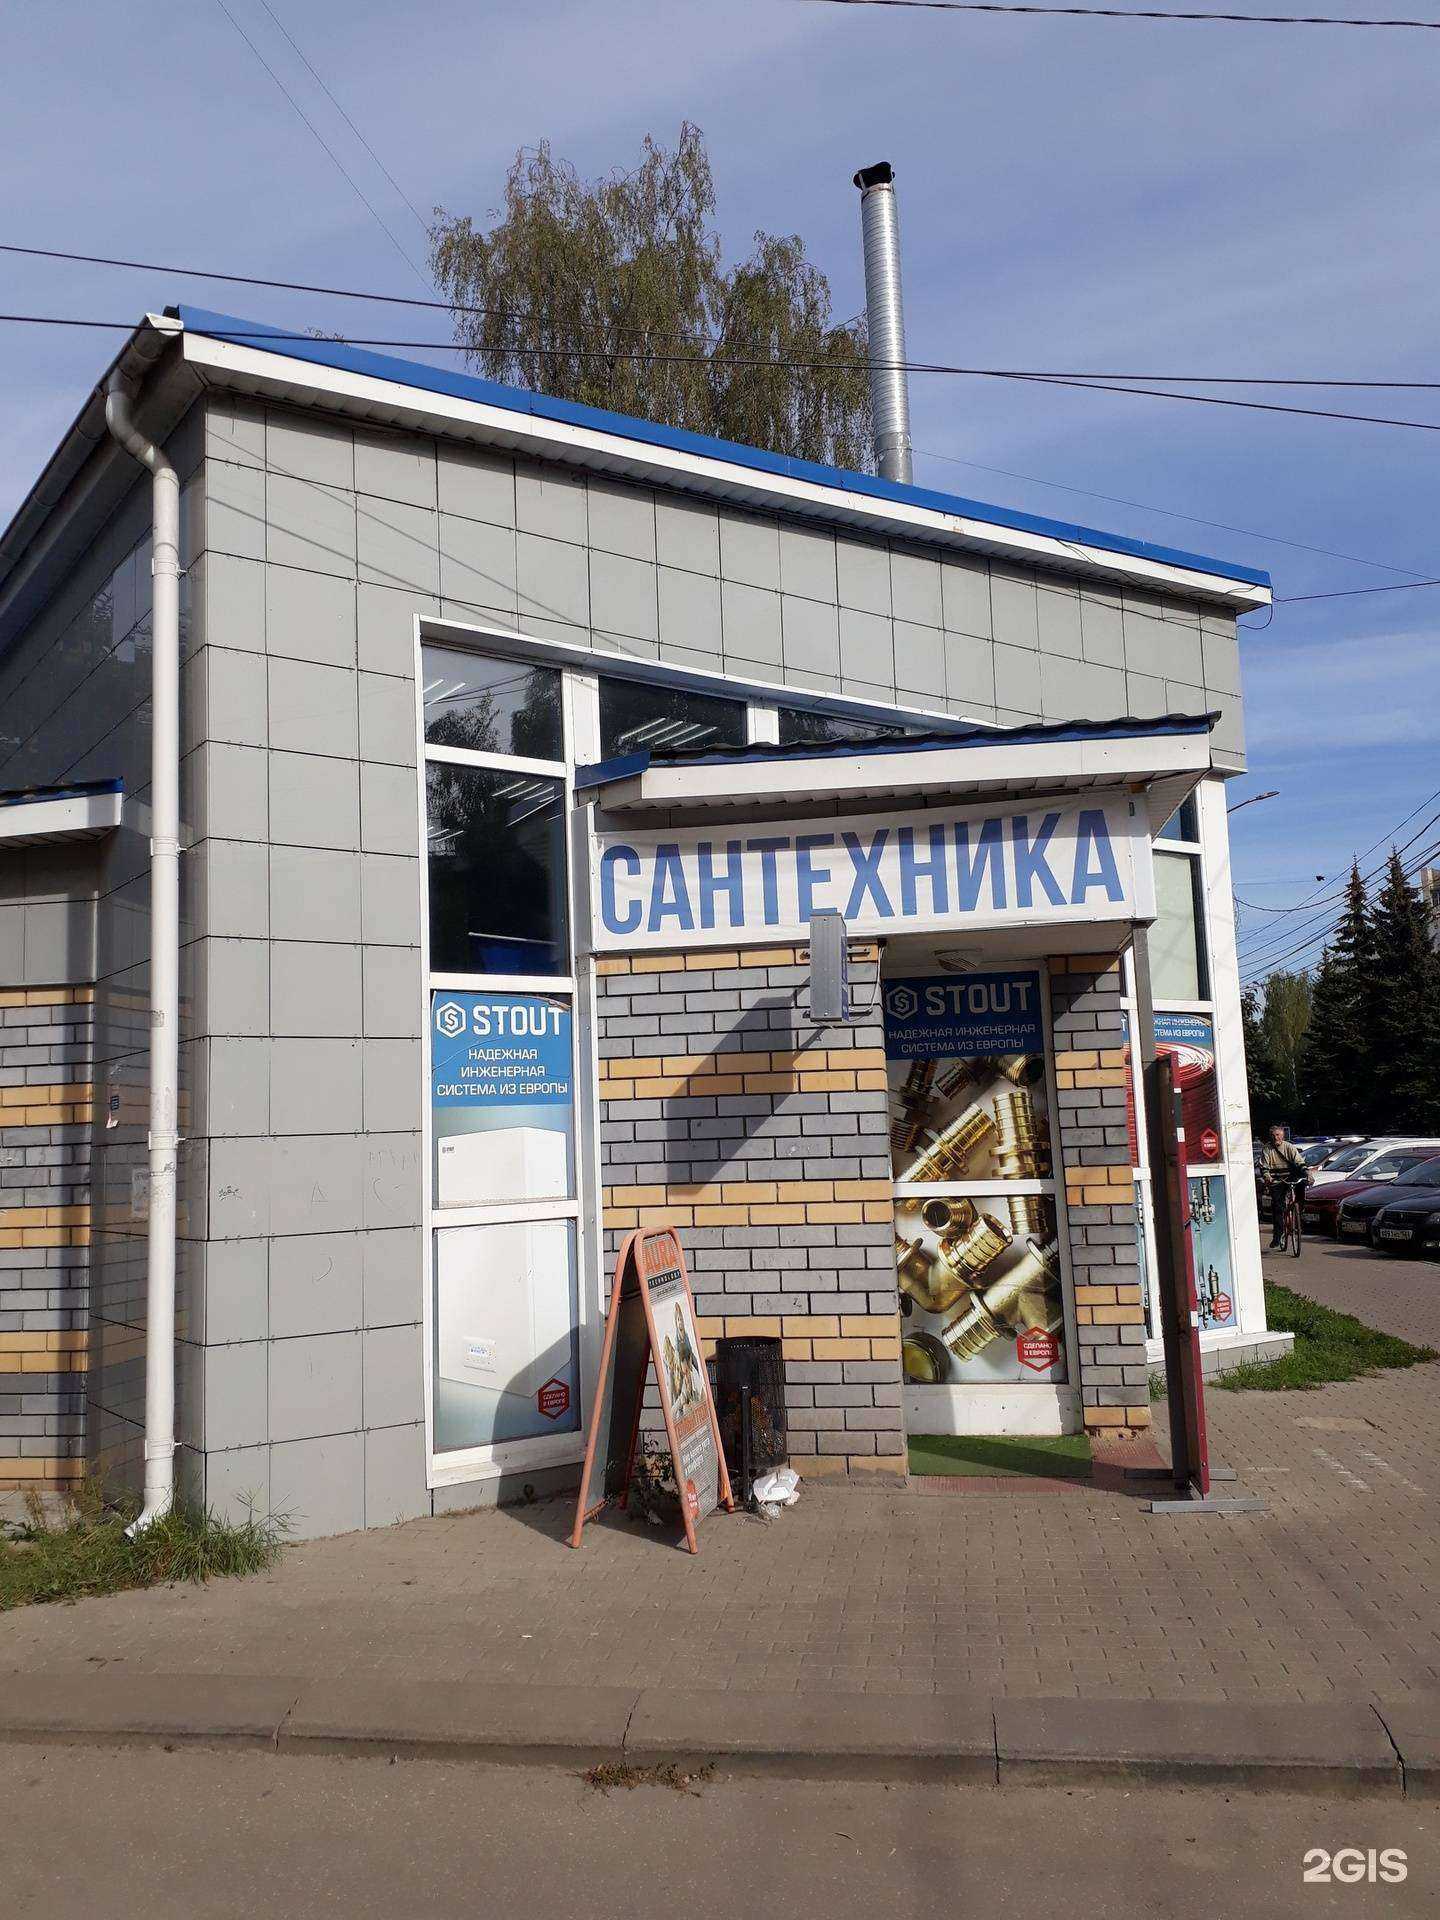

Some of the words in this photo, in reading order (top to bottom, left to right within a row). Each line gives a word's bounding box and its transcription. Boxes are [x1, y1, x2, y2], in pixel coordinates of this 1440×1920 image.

[600, 808, 1125, 935] САНТЕХНИКА
[925, 981, 1033, 1016] STOUT
[473, 1005, 564, 1036] STOUT
[888, 1028, 953, 1040] НАДЕЖНАЯ
[955, 1023, 1036, 1037] ИНЖЕНЕРНАЯ
[901, 1041, 954, 1054] СИСТЕМА
[957, 1040, 974, 1051] ИЗ
[976, 1038, 1024, 1050] ЕВРОПЫ
[468, 1048, 538, 1061] НАДЕЖНАЯ
[461, 1066, 545, 1078] ИНЖЕНЕРНАЯ
[437, 1084, 497, 1096] СИСТЕМА
[500, 1083, 517, 1095] ИЗ
[520, 1082, 568, 1094] ЕВРОПЫ
